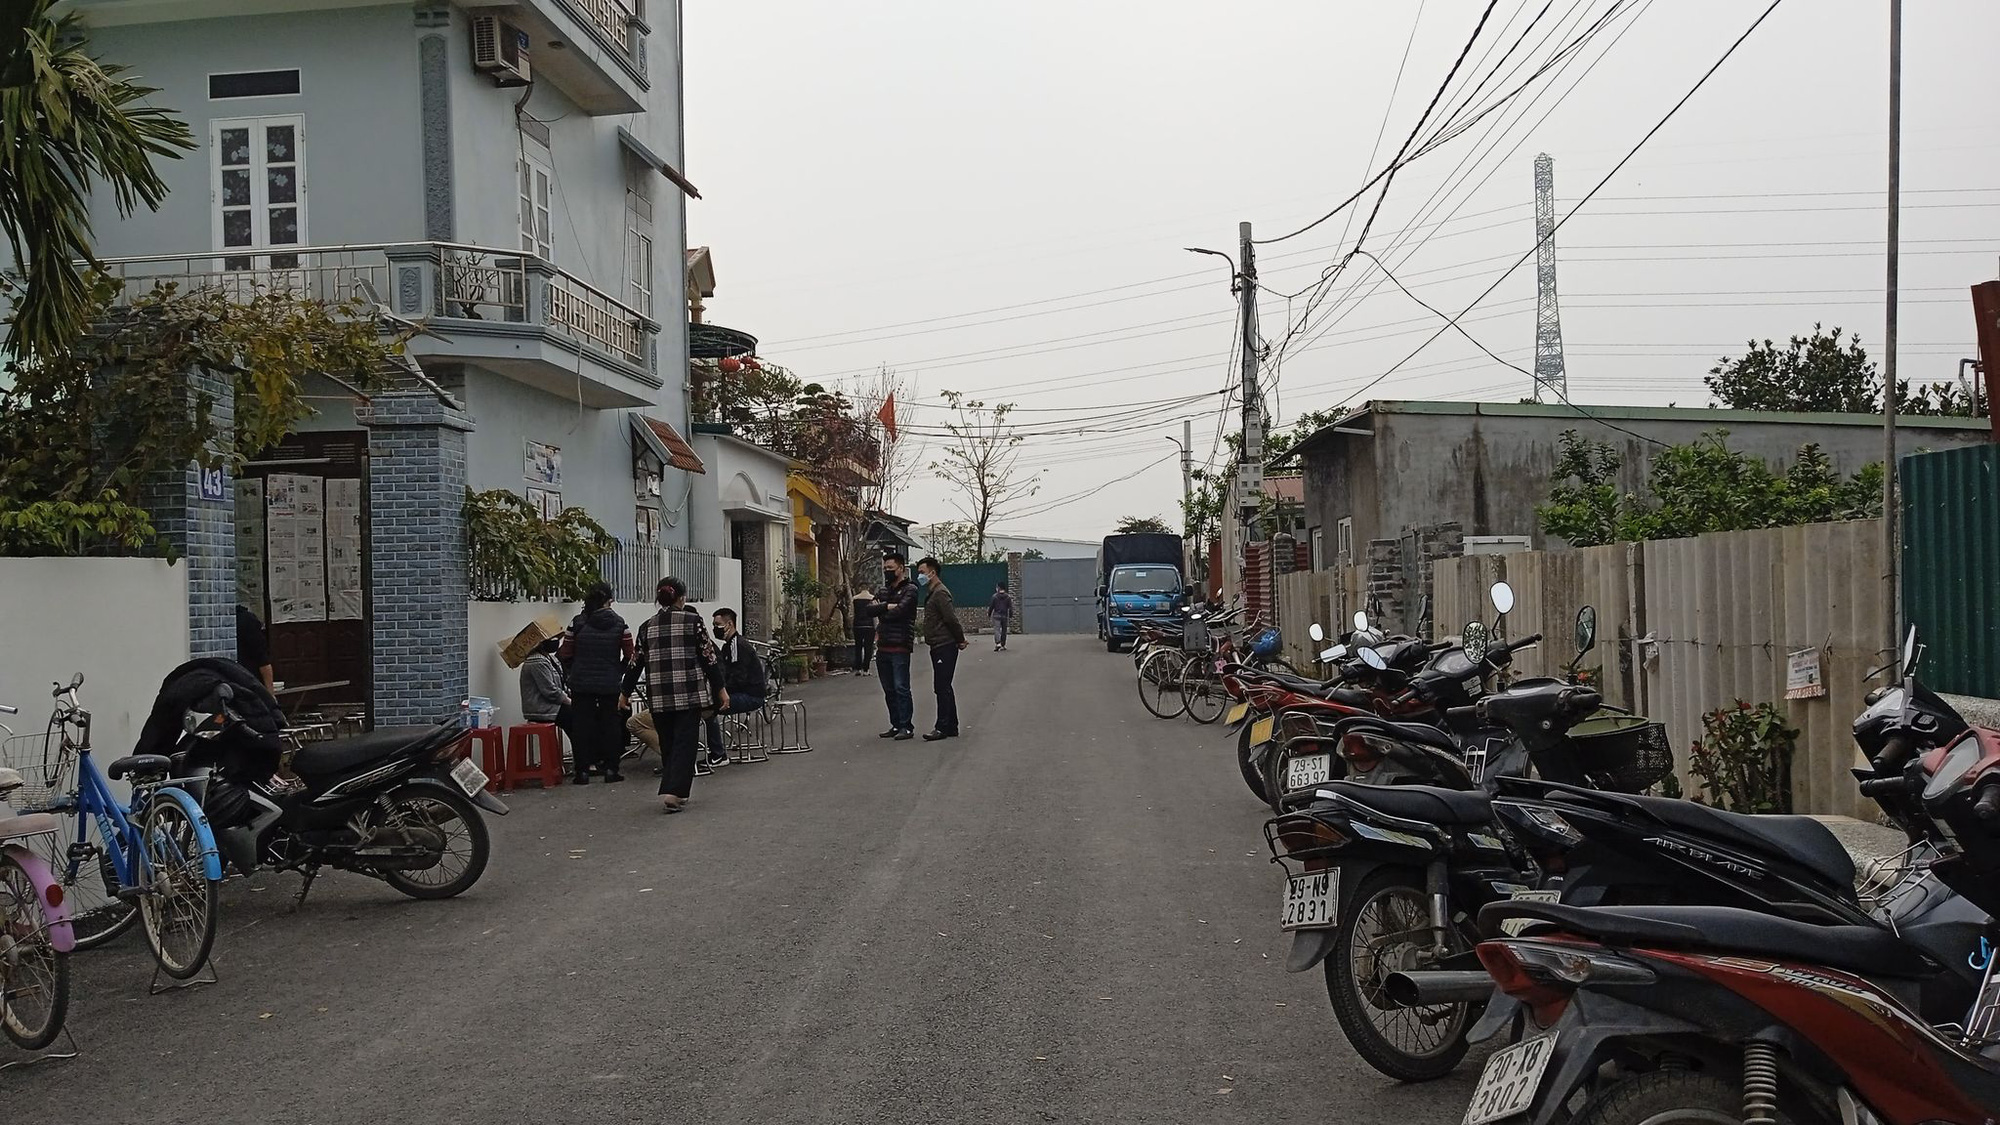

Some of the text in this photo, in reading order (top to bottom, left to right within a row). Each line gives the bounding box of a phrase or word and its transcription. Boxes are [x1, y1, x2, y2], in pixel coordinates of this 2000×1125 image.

[204, 467, 222, 496] 43
[1294, 756, 1322, 773] 29-S1
[1288, 874, 1329, 901] 29-N9
[1287, 899, 1326, 925] 2831
